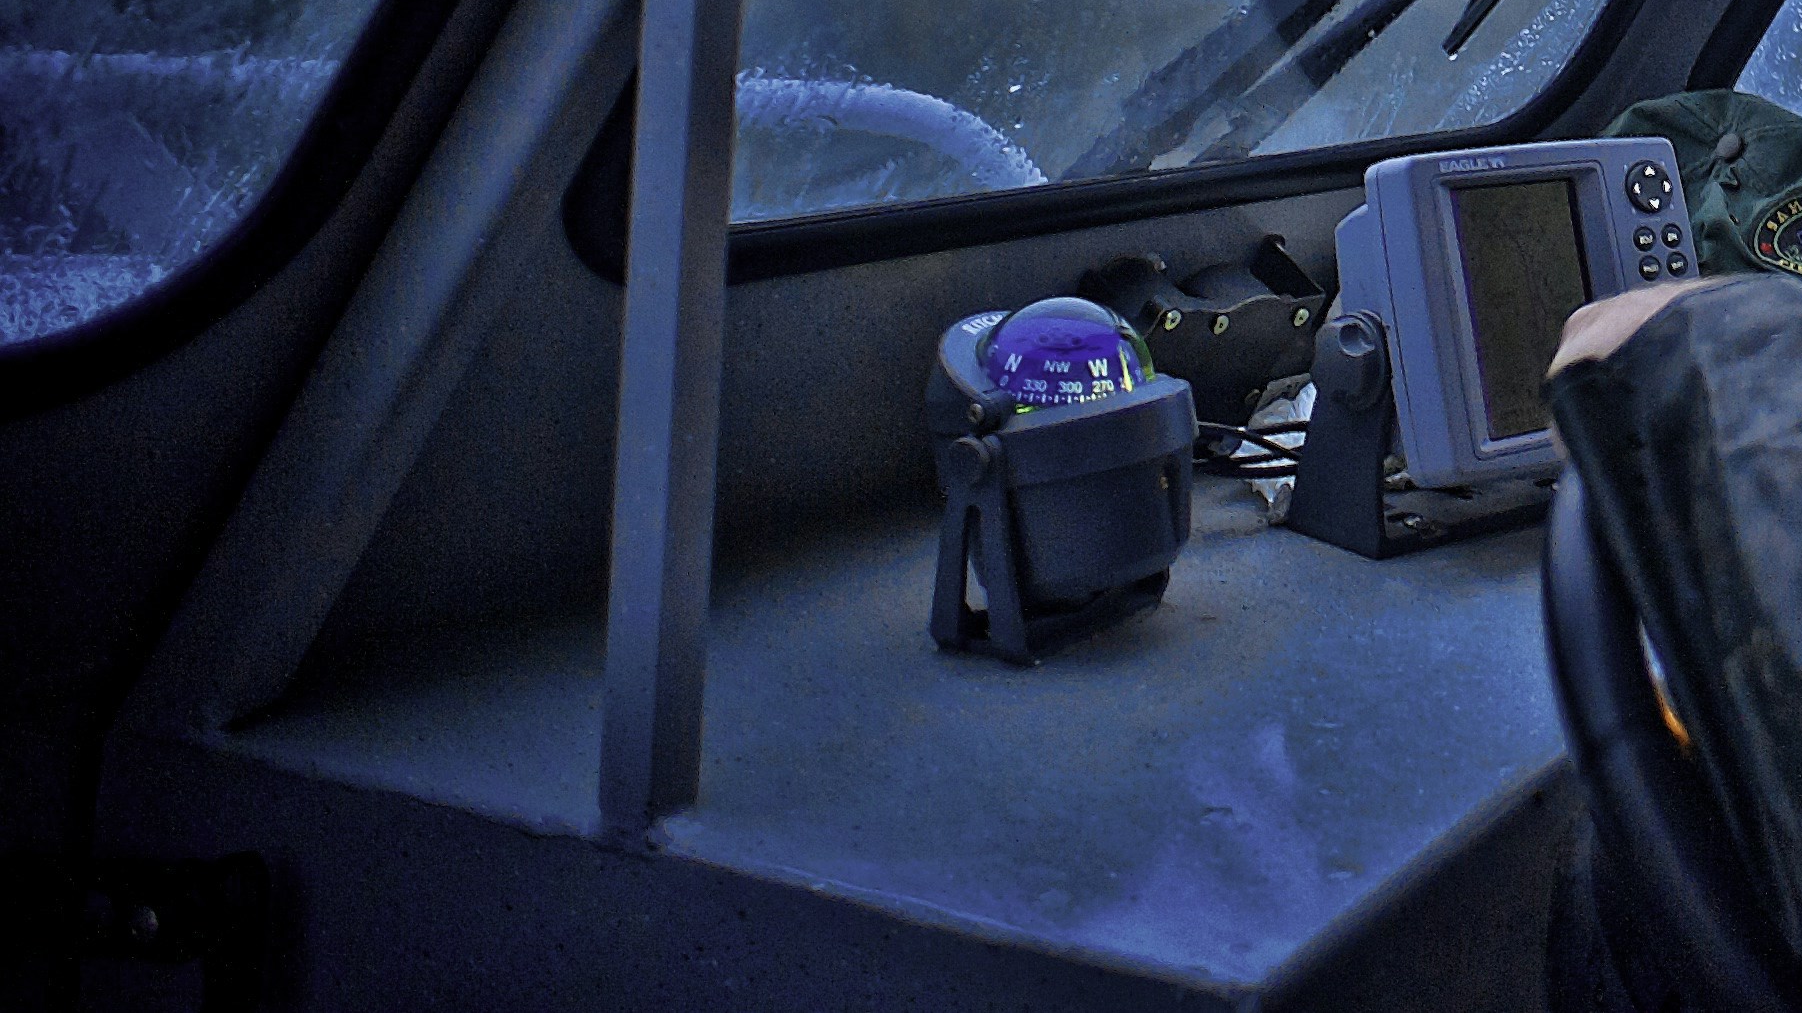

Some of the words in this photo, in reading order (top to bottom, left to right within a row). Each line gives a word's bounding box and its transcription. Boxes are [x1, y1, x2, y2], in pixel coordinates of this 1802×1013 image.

[1439, 158, 1489, 173] EAGLE
[1004, 353, 1022, 373] N
[1043, 359, 1071, 374] NW
[1088, 357, 1108, 378] W
[1023, 378, 1047, 392] 330
[1057, 381, 1083, 394] 300
[1092, 379, 1115, 394] 270
